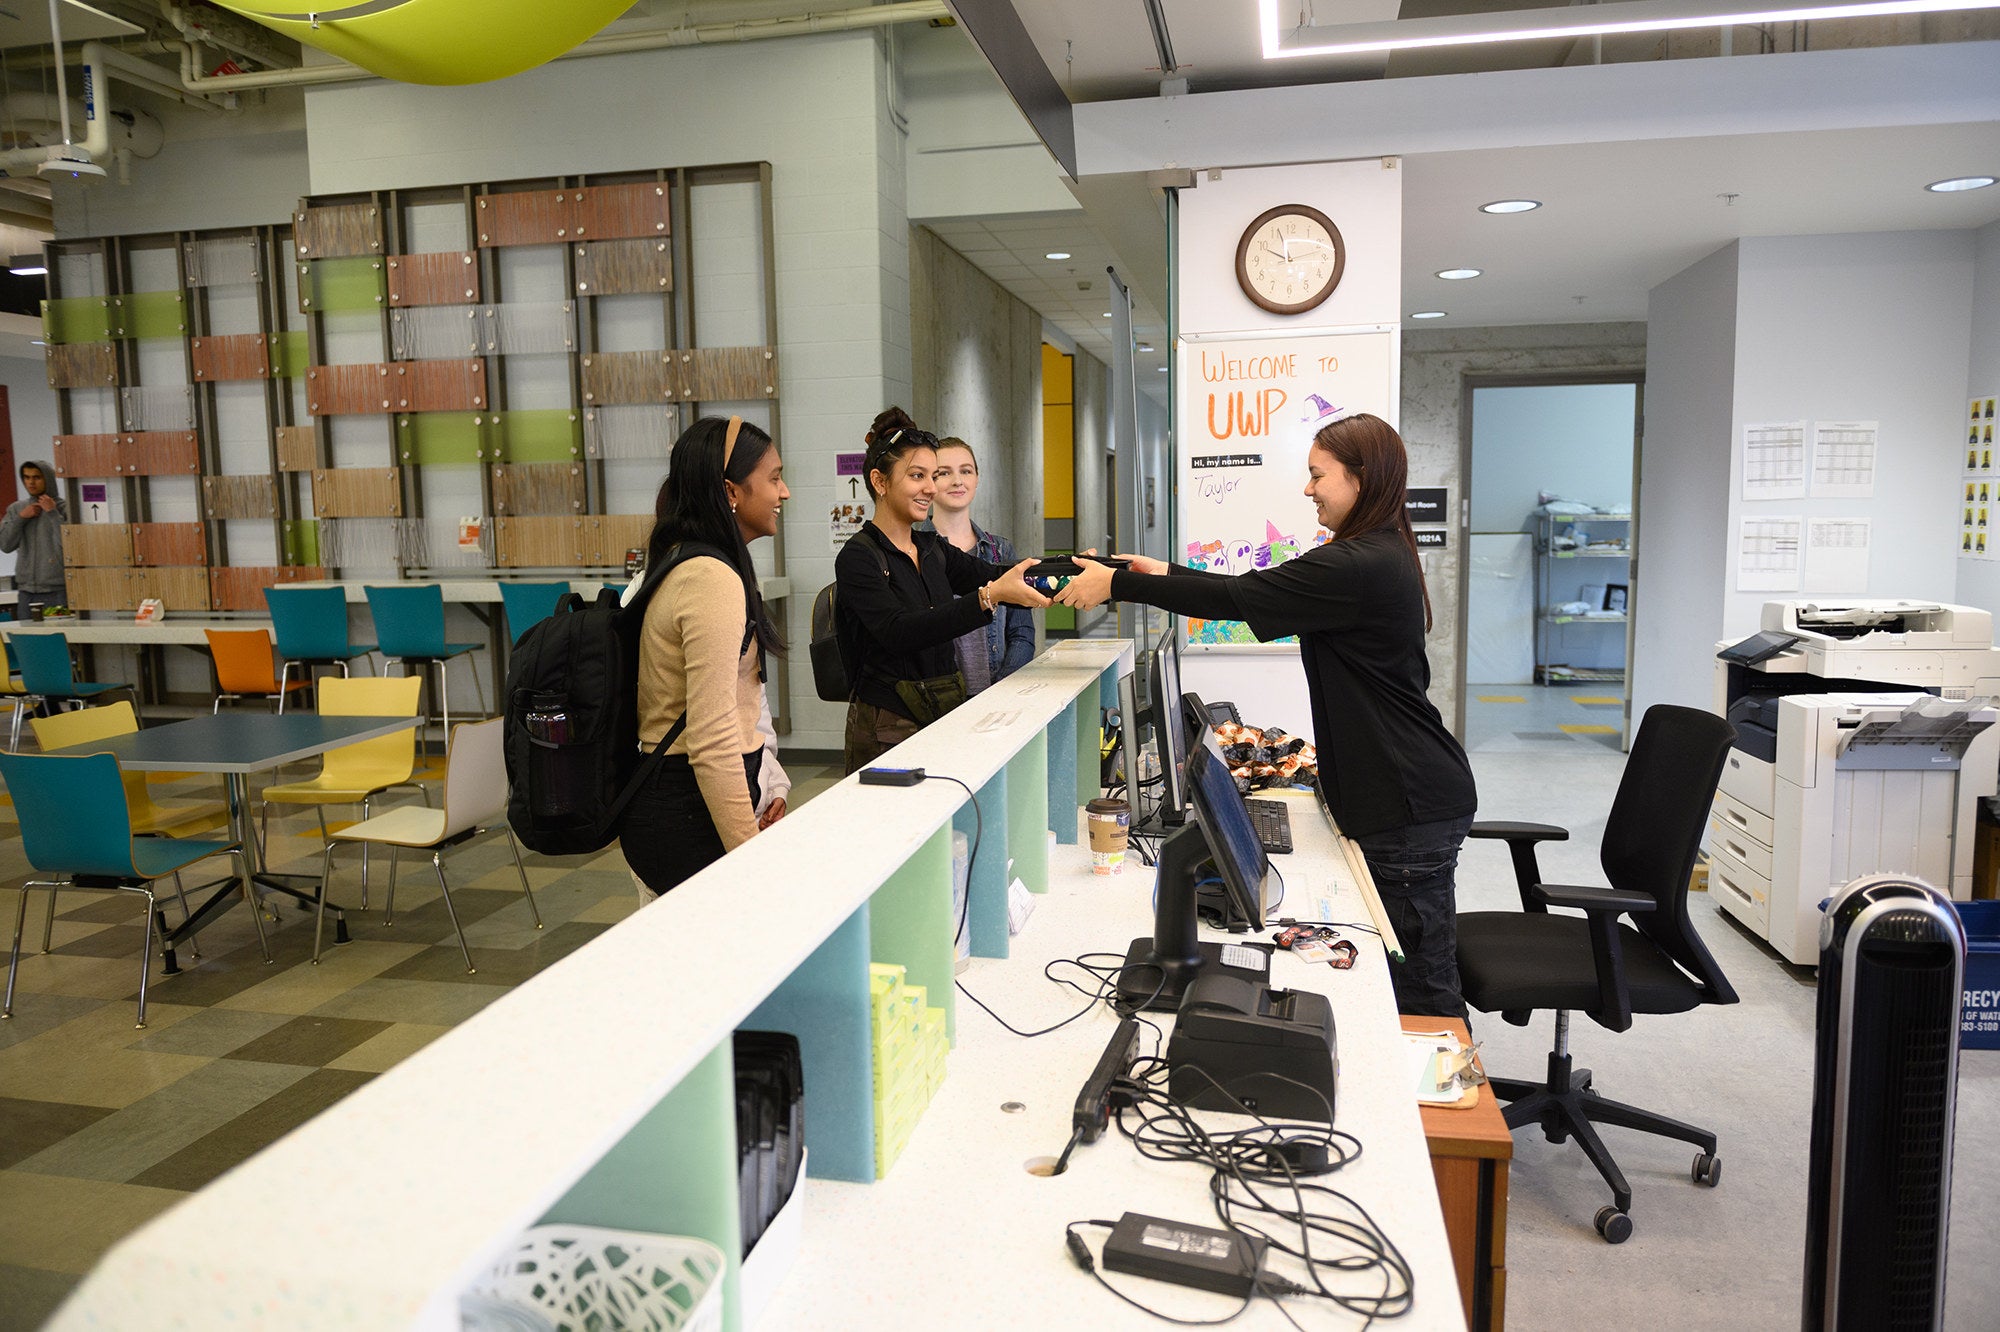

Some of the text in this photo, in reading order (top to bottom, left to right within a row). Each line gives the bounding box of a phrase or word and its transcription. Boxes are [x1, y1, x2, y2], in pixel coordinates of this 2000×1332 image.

[1201, 350, 1339, 382] WELCOME TO
[1207, 388, 1288, 440] UWP
[1193, 459, 1205, 467] Hi,
[1206, 459, 1220, 467] my
[1194, 474, 1242, 504] Taylor
[1418, 501, 1437, 509] Room
[1963, 990, 2000, 1007] RECY
[1966, 1011, 1978, 1020] OF
